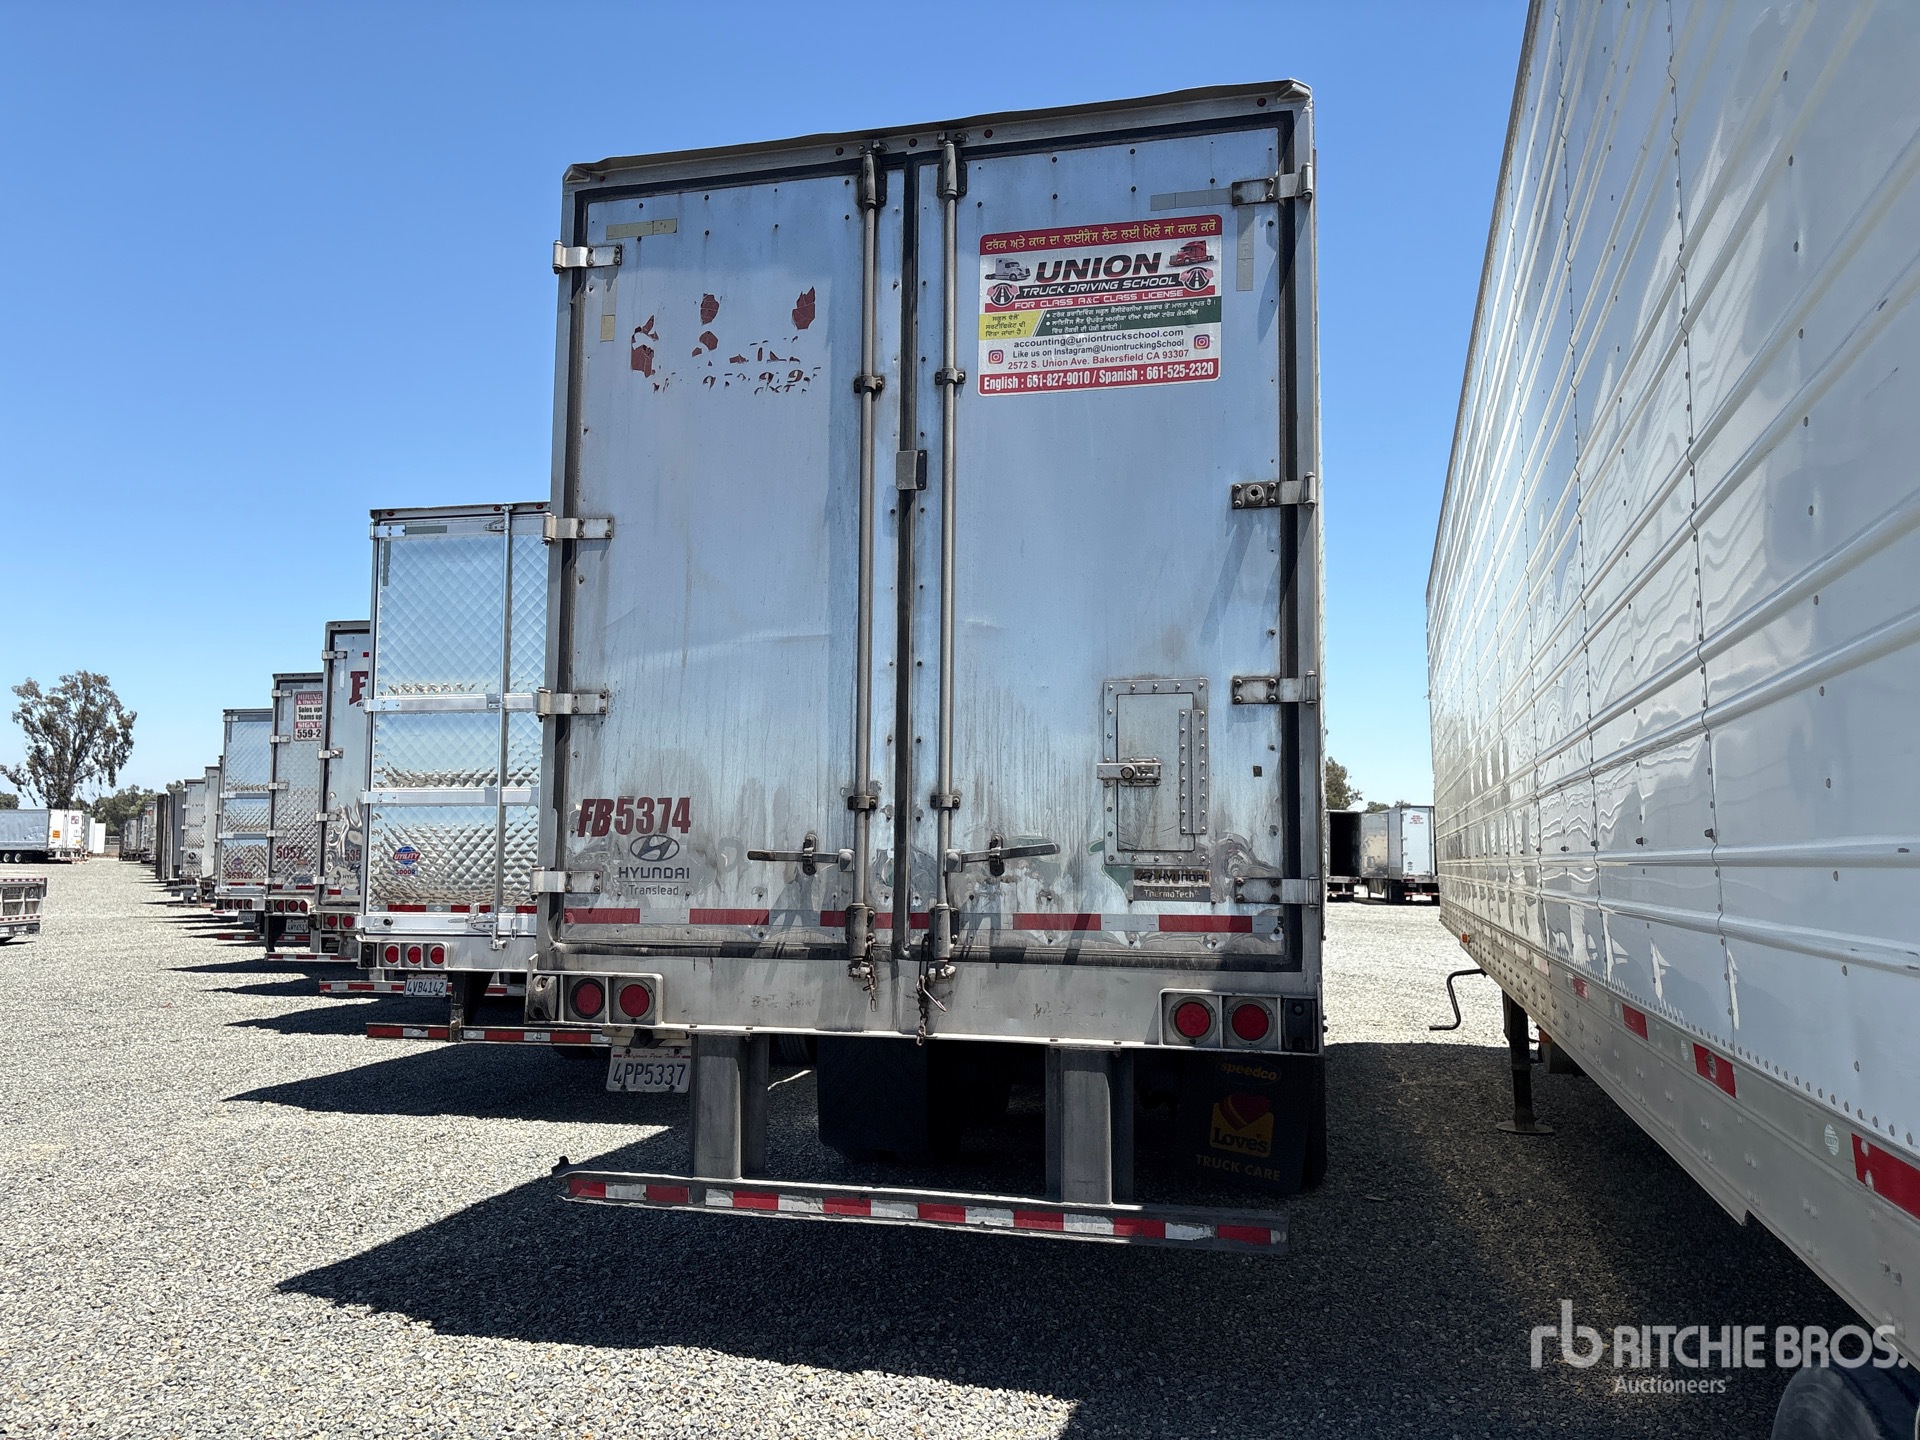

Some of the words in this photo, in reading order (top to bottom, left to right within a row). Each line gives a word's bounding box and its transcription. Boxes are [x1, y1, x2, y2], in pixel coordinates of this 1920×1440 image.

[1010, 235, 1025, 249] ਅਤੇ
[1029, 236, 1046, 246] ਕਾਰ
[1049, 235, 1060, 246] ਦਾ
[1121, 225, 1140, 240] ਲਈ
[1178, 223, 1197, 235] ਕਾਲ
[1036, 252, 1162, 283] UNION
[1023, 285, 1065, 297] TRUCK
[1068, 281, 1119, 293] DRIVING
[1122, 277, 1176, 289] SCHOOL
[1015, 301, 1036, 310] FOR
[1040, 297, 1073, 308] CLASS
[1078, 296, 1100, 305] A&C
[1103, 292, 1138, 302] CLASS
[1142, 290, 1184, 300] LICENSE
[1014, 329, 1184, 348] accounting@uniontruckschool.com
[1012, 350, 1028, 359] Like
[1054, 339, 1184, 356] Instagram@UniontruckingSchool
[1008, 361, 1028, 370] 2572
[1042, 358, 1068, 368] Union
[1070, 357, 1090, 366] Ave.
[1092, 353, 1143, 365] Bakersfield
[1146, 351, 1160, 360] CA
[1162, 349, 1189, 359] 93307
[984, 375, 1019, 391] English
[1026, 370, 1090, 388] 661-827-9010
[1099, 368, 1138, 384] Spanish
[1146, 362, 1214, 380] 661-525-2320
[577, 796, 691, 837] FB5374
[618, 866, 690, 879] HYUNDAI
[628, 884, 679, 896] Translead
[407, 981, 444, 993] 4VB4142
[613, 1062, 686, 1086] 4PP5337
[1219, 1062, 1278, 1081] speedco
[1195, 1154, 1241, 1173] TRUCK
[1244, 1164, 1281, 1181] CARE
